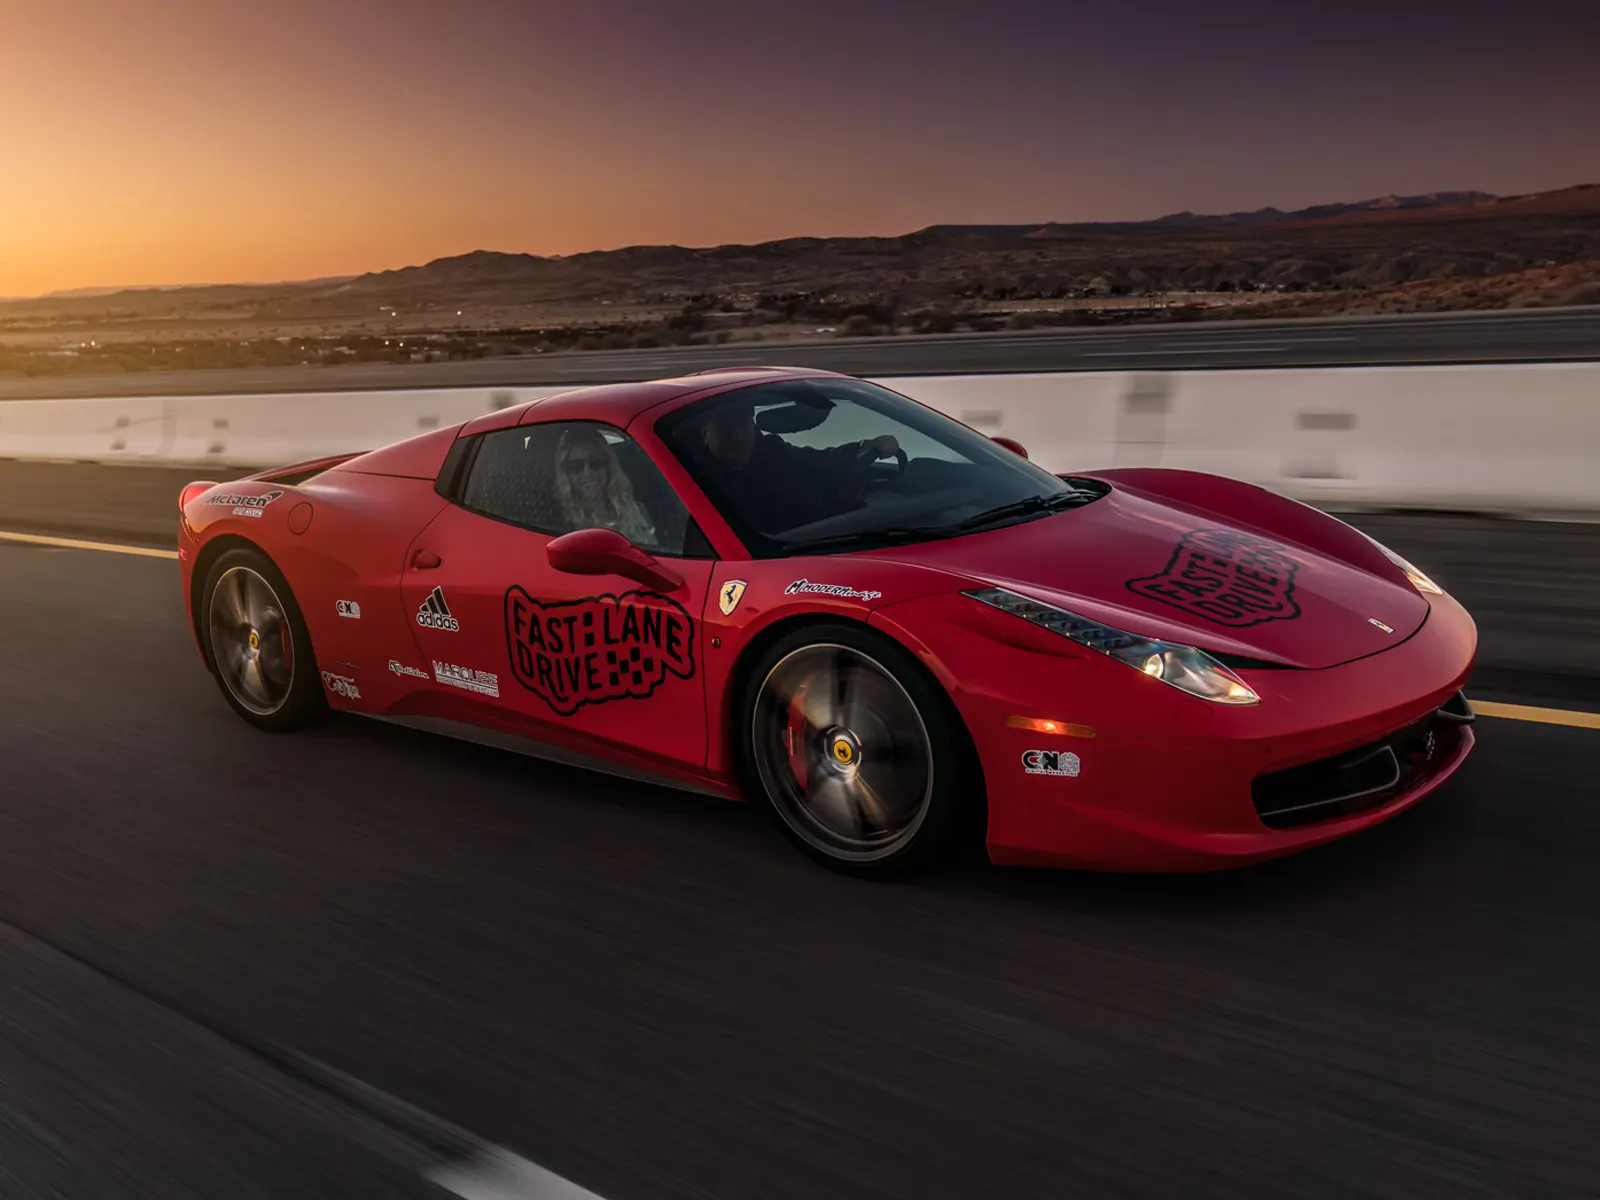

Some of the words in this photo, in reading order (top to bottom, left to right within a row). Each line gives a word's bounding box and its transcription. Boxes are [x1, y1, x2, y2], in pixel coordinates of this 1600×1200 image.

[206, 494, 267, 507] McLaren
[1144, 560, 1229, 601] FAST
[1190, 564, 1284, 619] DRIVE
[417, 613, 459, 631] adidas
[513, 598, 578, 654] FAST
[603, 603, 684, 665] LANE
[433, 660, 498, 687] MARQUEE
[515, 638, 602, 703] DRIVE
